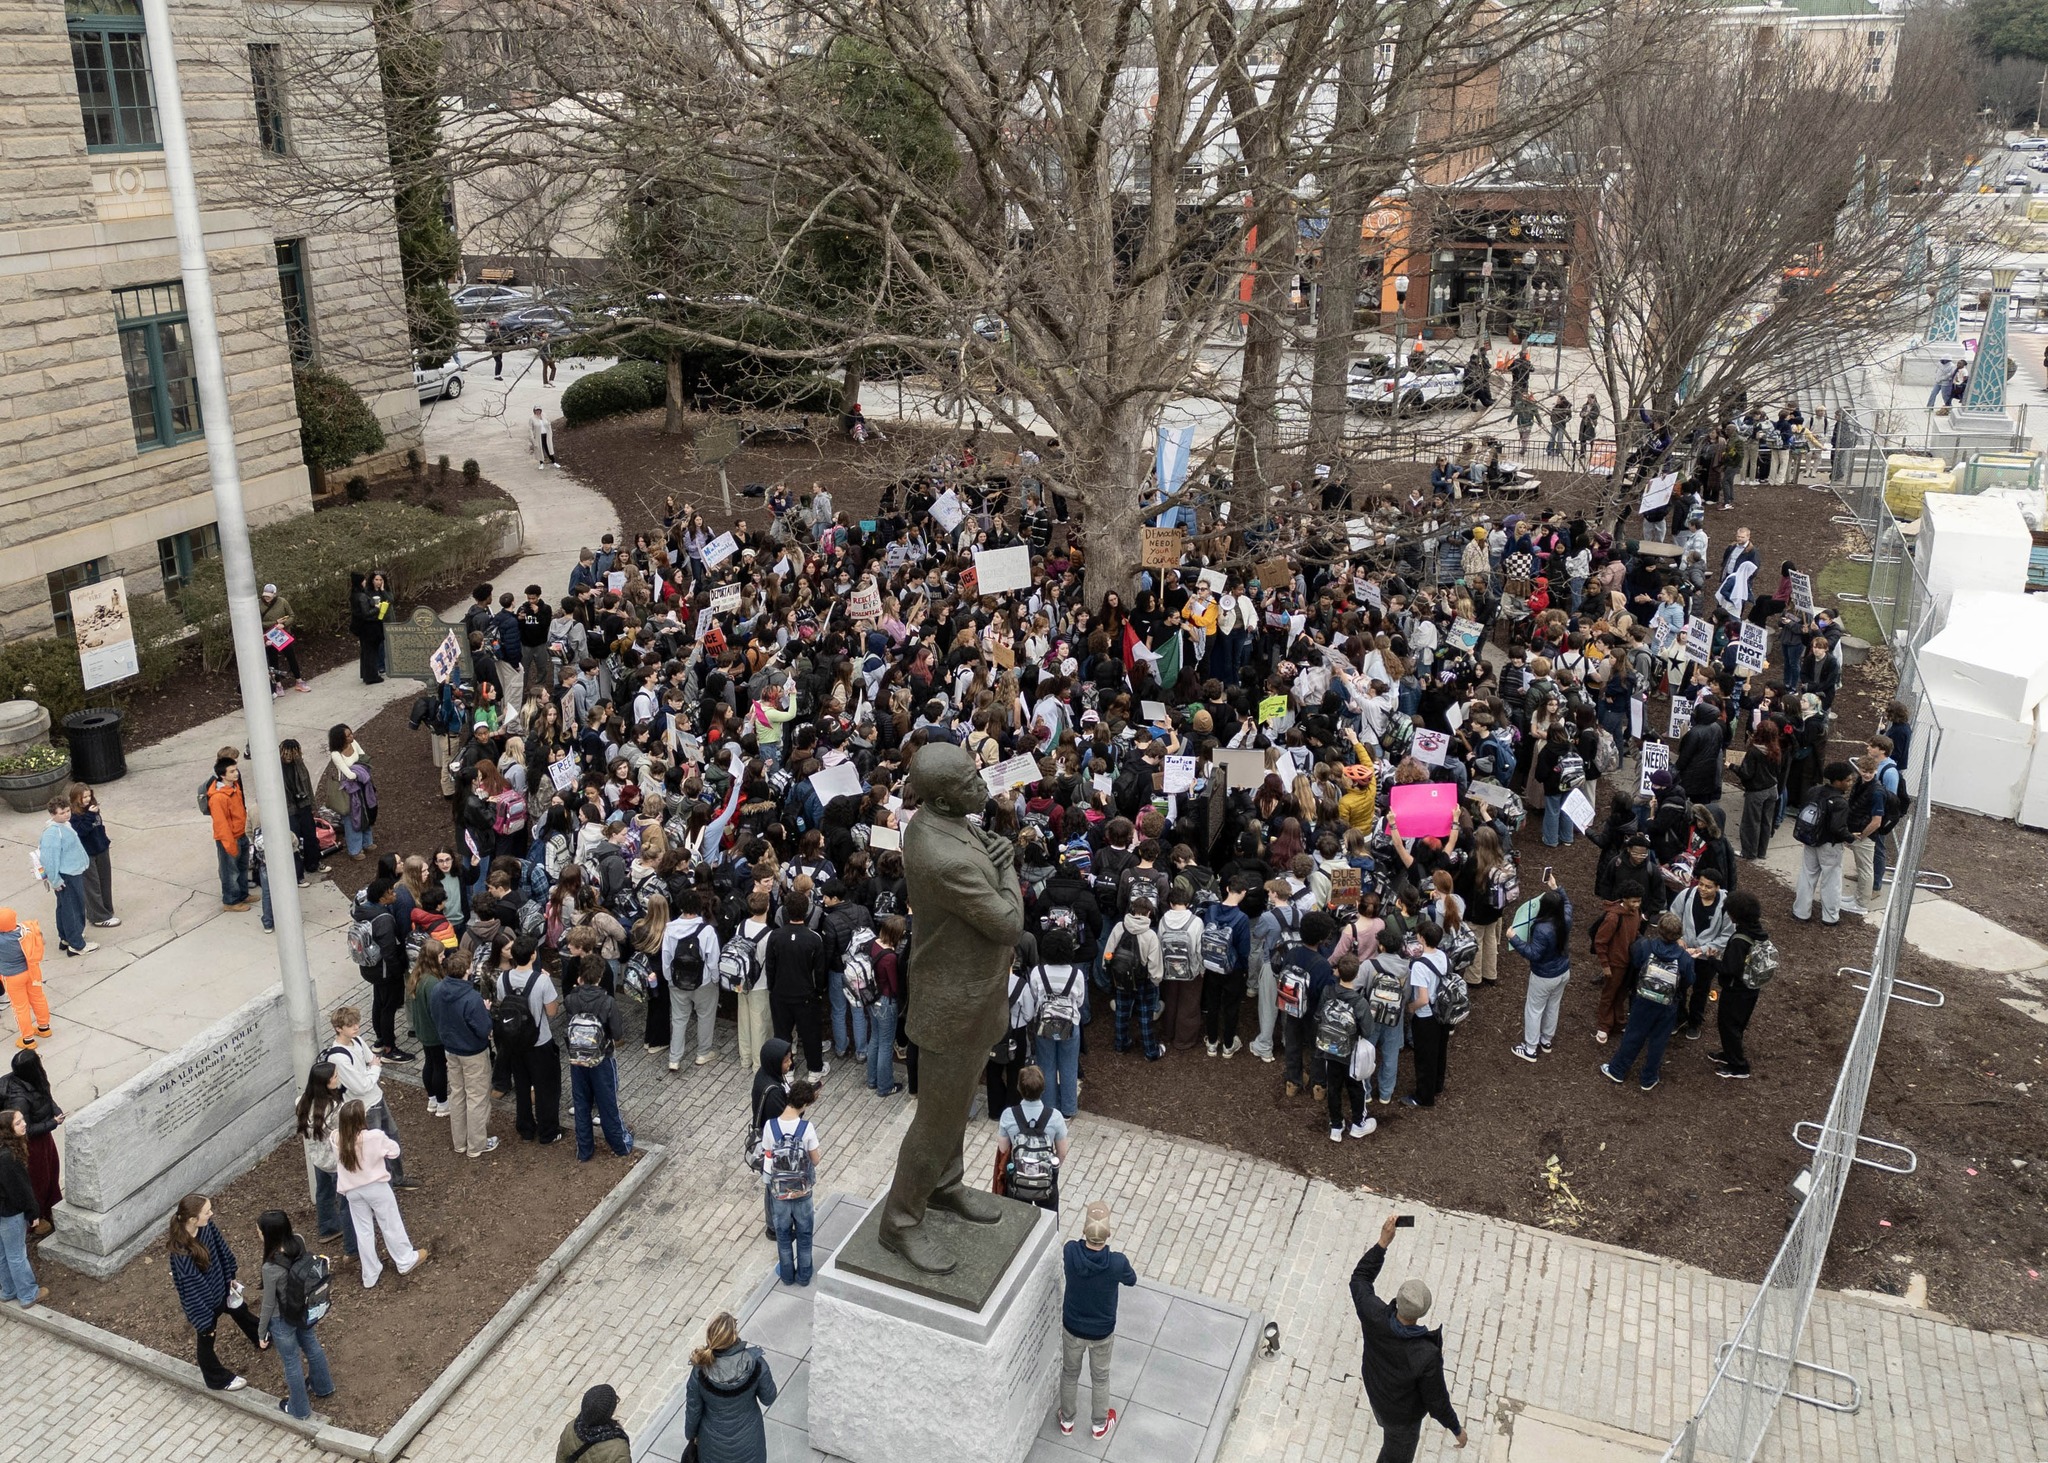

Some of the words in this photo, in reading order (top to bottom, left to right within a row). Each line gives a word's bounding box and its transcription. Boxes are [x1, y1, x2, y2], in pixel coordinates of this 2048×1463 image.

[1146, 556, 1178, 565] COURAGE
[962, 572, 974, 584] ICE
[1695, 620, 1706, 632] FULL
[704, 633, 717, 644] ICE
[1691, 628, 1708, 643] RIGHTS
[1744, 630, 1762, 643] PEOPLE'S
[1687, 640, 1697, 648] FOR
[1698, 646, 1708, 654] ALL
[1741, 636, 1763, 650] NEEDS
[708, 645, 724, 656] OUT
[1740, 645, 1762, 658] NOT
[1745, 656, 1750, 664] &
[1751, 658, 1761, 669] WAR
[550, 756, 571, 776] FREE
[1645, 751, 1668, 770] NEEDS
[1332, 870, 1356, 878] DUE
[1332, 879, 1360, 887] PROCESS
[195, 1042, 228, 1068] COUNTY
[232, 1022, 259, 1044] POLICE
[182, 1054, 226, 1087] ESTABLISHED
